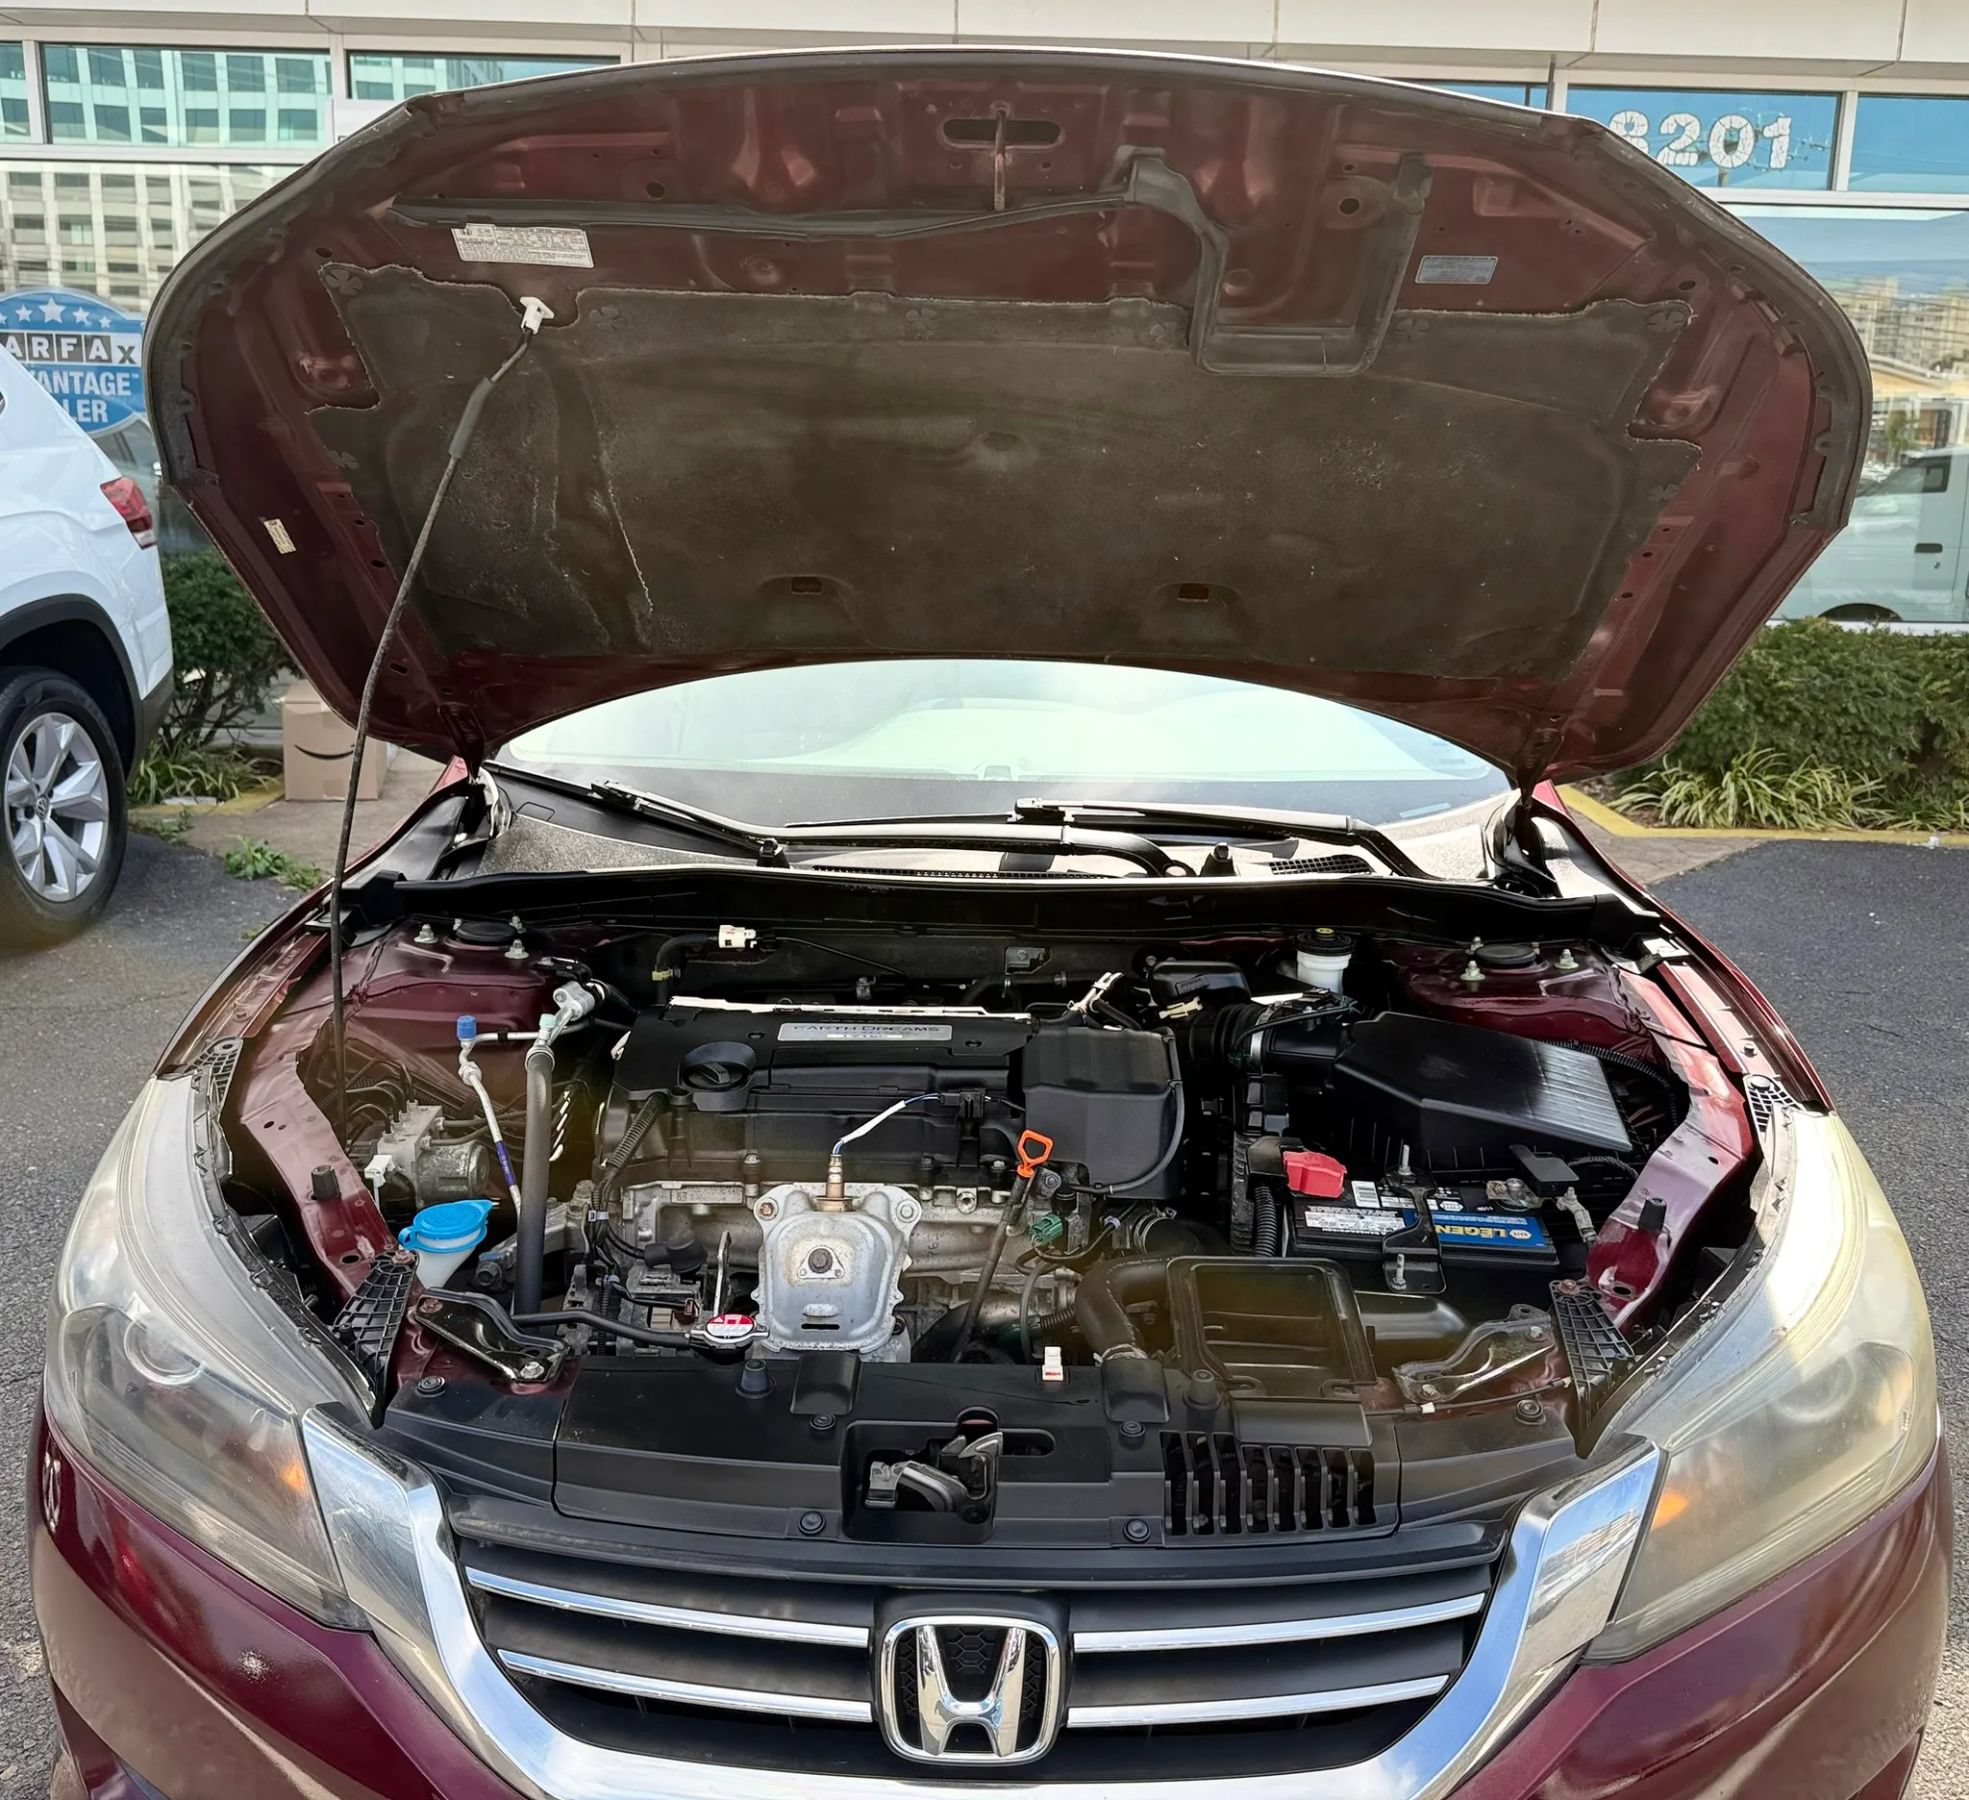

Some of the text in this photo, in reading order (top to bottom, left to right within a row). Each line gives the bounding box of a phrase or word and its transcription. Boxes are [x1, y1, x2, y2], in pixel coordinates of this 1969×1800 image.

[1608, 110, 1792, 169] 8201
[5, 335, 136, 365] ARFAX
[38, 370, 132, 396] ANTAGE
[61, 398, 109, 423] LER
[1435, 1225, 1507, 1238] LEGEN
